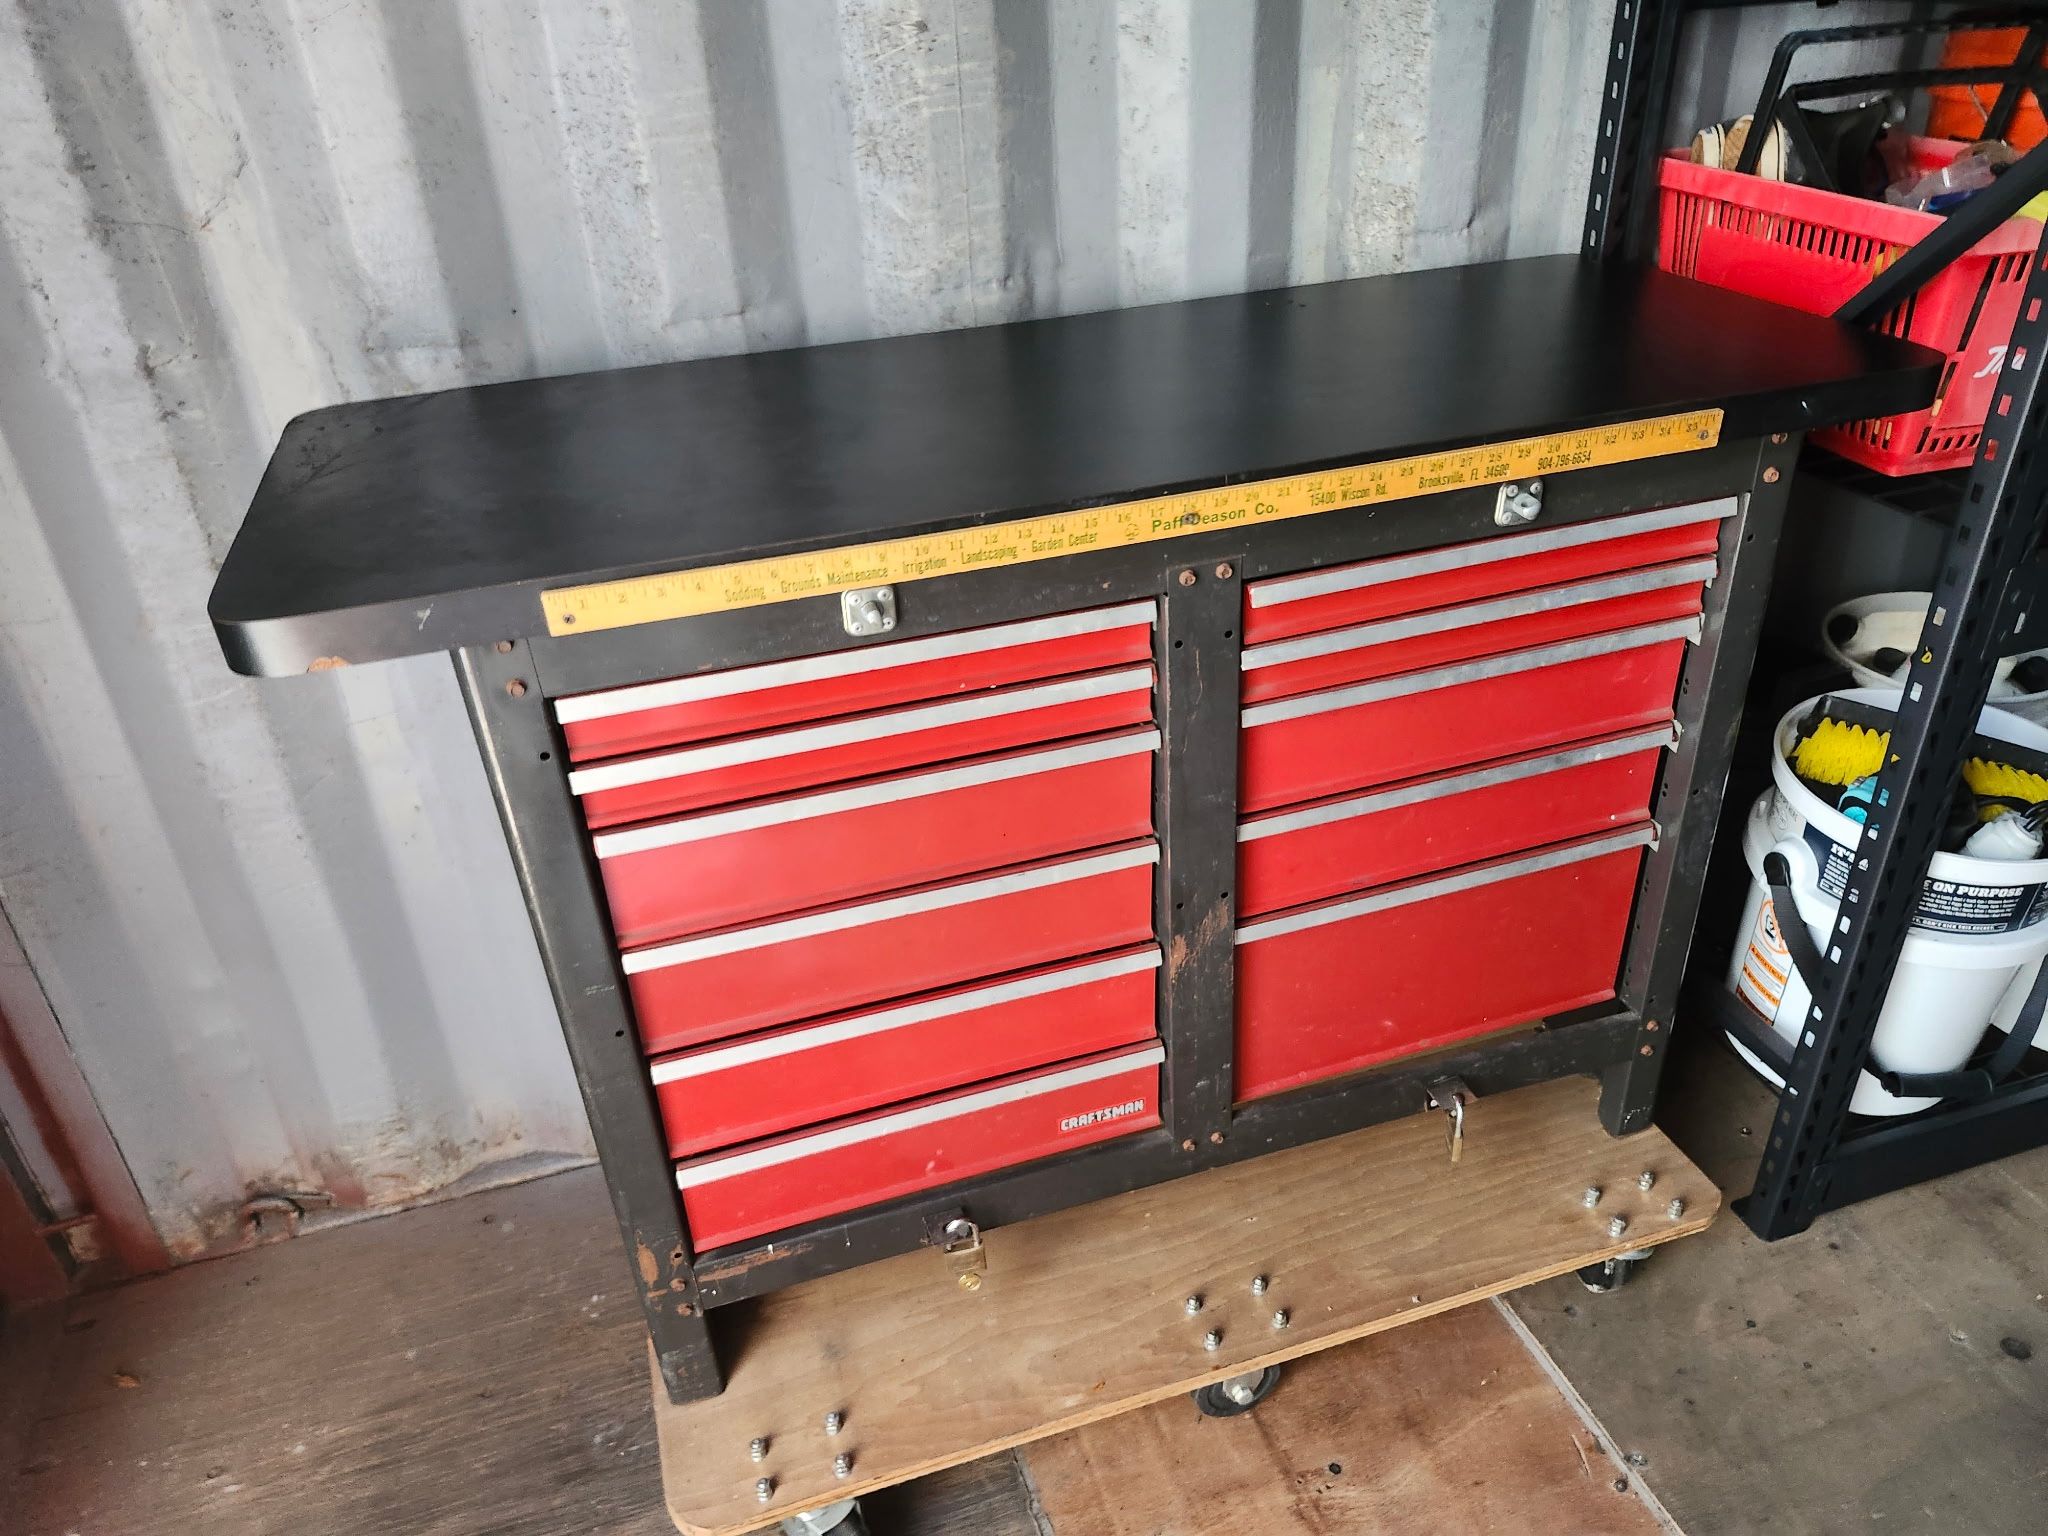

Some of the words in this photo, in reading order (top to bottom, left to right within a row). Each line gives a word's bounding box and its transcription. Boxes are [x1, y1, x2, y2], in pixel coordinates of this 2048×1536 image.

[1470, 468, 1479, 481] FL
[915, 546, 929, 556] 10
[950, 539, 964, 550] 11
[984, 534, 998, 545] 12
[1018, 529, 1032, 539] 13
[1052, 523, 1065, 533] 14
[1085, 518, 1098, 529] 15
[1118, 513, 1131, 523] 16
[1151, 507, 1164, 518] 17
[1215, 498, 1229, 508] 19
[1245, 492, 1260, 503] 20
[1277, 487, 1291, 497] 21
[1307, 481, 1323, 492] 22
[1339, 476, 1353, 487] 23
[1370, 471, 1383, 482] 24
[1401, 466, 1414, 477] 25
[1430, 462, 1444, 472] 26
[1460, 457, 1473, 467] 27
[1518, 448, 1531, 459] 29
[1548, 443, 1561, 453] 30
[1576, 440, 1588, 449] 31
[1604, 434, 1617, 445] 32
[1632, 430, 1645, 440] 33
[1659, 427, 1672, 437] 34
[1686, 422, 1698, 433] 35
[1310, 490, 1336, 507] 15400
[1341, 486, 1370, 502] Wiscon
[1375, 483, 1388, 496] Rd.
[1255, 503, 1279, 516] Co.
[725, 586, 767, 603] Sodding
[781, 577, 822, 594] Grounds
[828, 566, 888, 585] Maintenance
[903, 556, 947, 574] Irrigation
[961, 545, 1017, 564] Landscaping
[1031, 537, 1064, 553] Garden
[1068, 532, 1098, 547] Center
[1932, 881, 1956, 893] ON
[1957, 885, 2024, 898] PURPOSE
[1060, 1099, 1144, 1131] CRAFTSMAN
